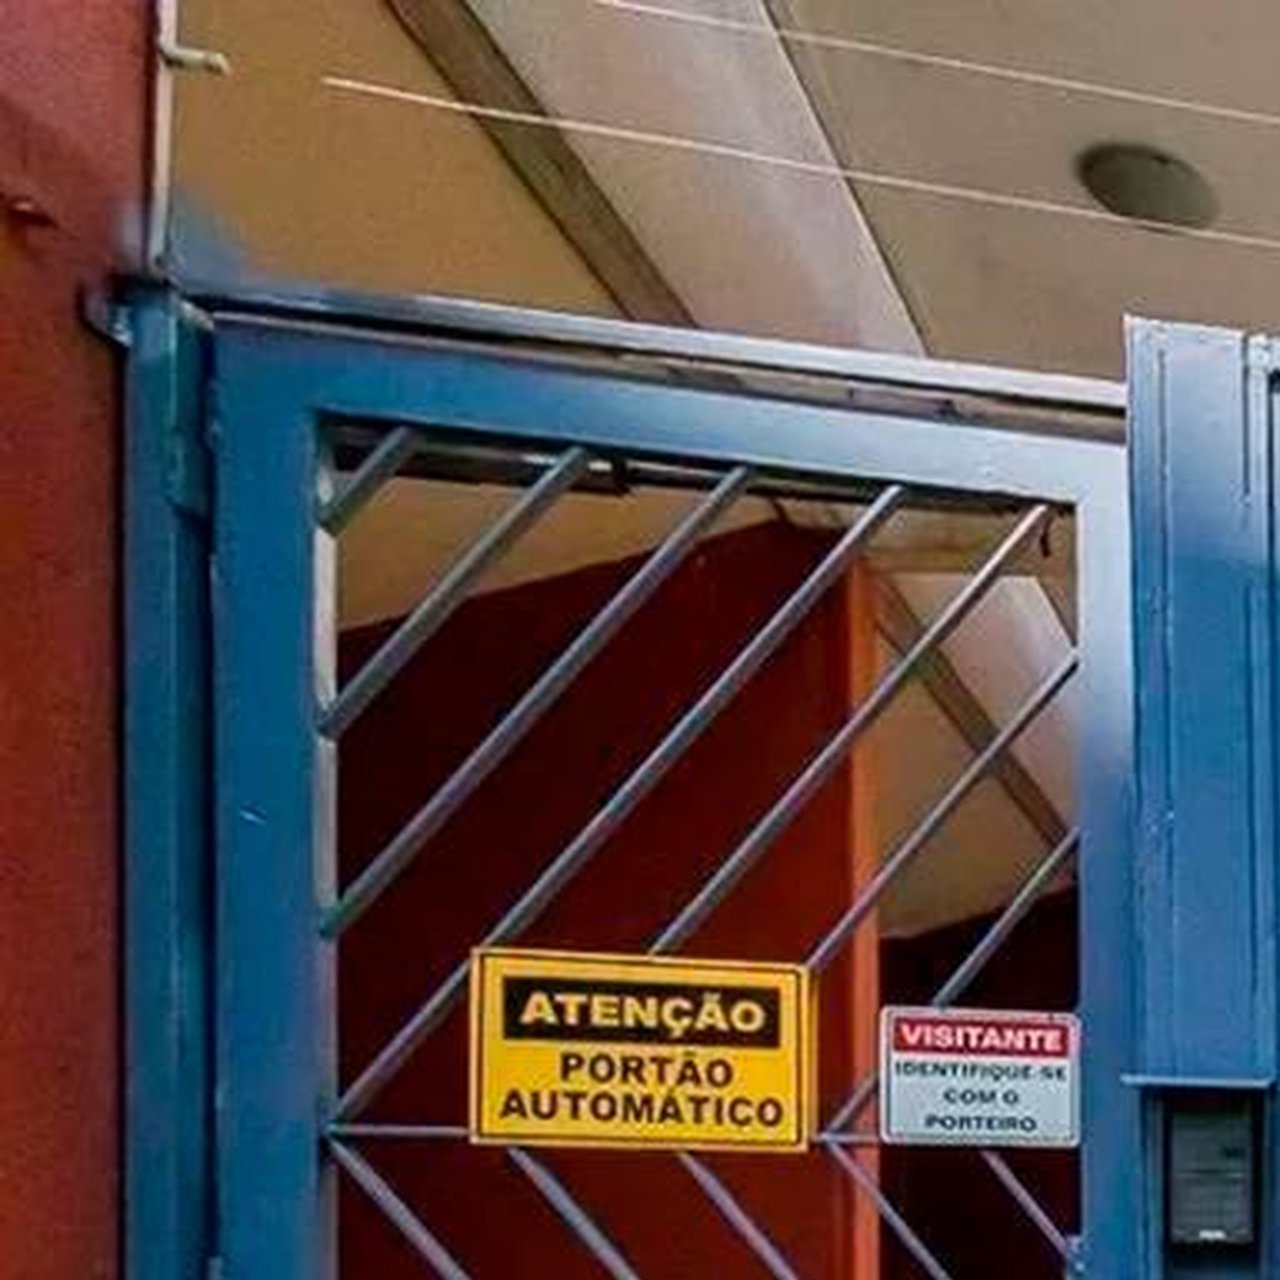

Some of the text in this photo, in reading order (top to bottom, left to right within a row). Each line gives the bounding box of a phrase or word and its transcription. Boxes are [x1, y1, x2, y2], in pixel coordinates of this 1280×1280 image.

[520, 991, 767, 1038] ATENÇÃO
[901, 1024, 1063, 1052] VISITANTE
[560, 1051, 734, 1088] PORTÃO
[895, 1061, 1067, 1082] IDENTIFIQUE-SE
[500, 1087, 784, 1127] AUTOMÁTICO
[943, 1088, 1019, 1105] COM O
[925, 1114, 1038, 1133] PORTEIRO
